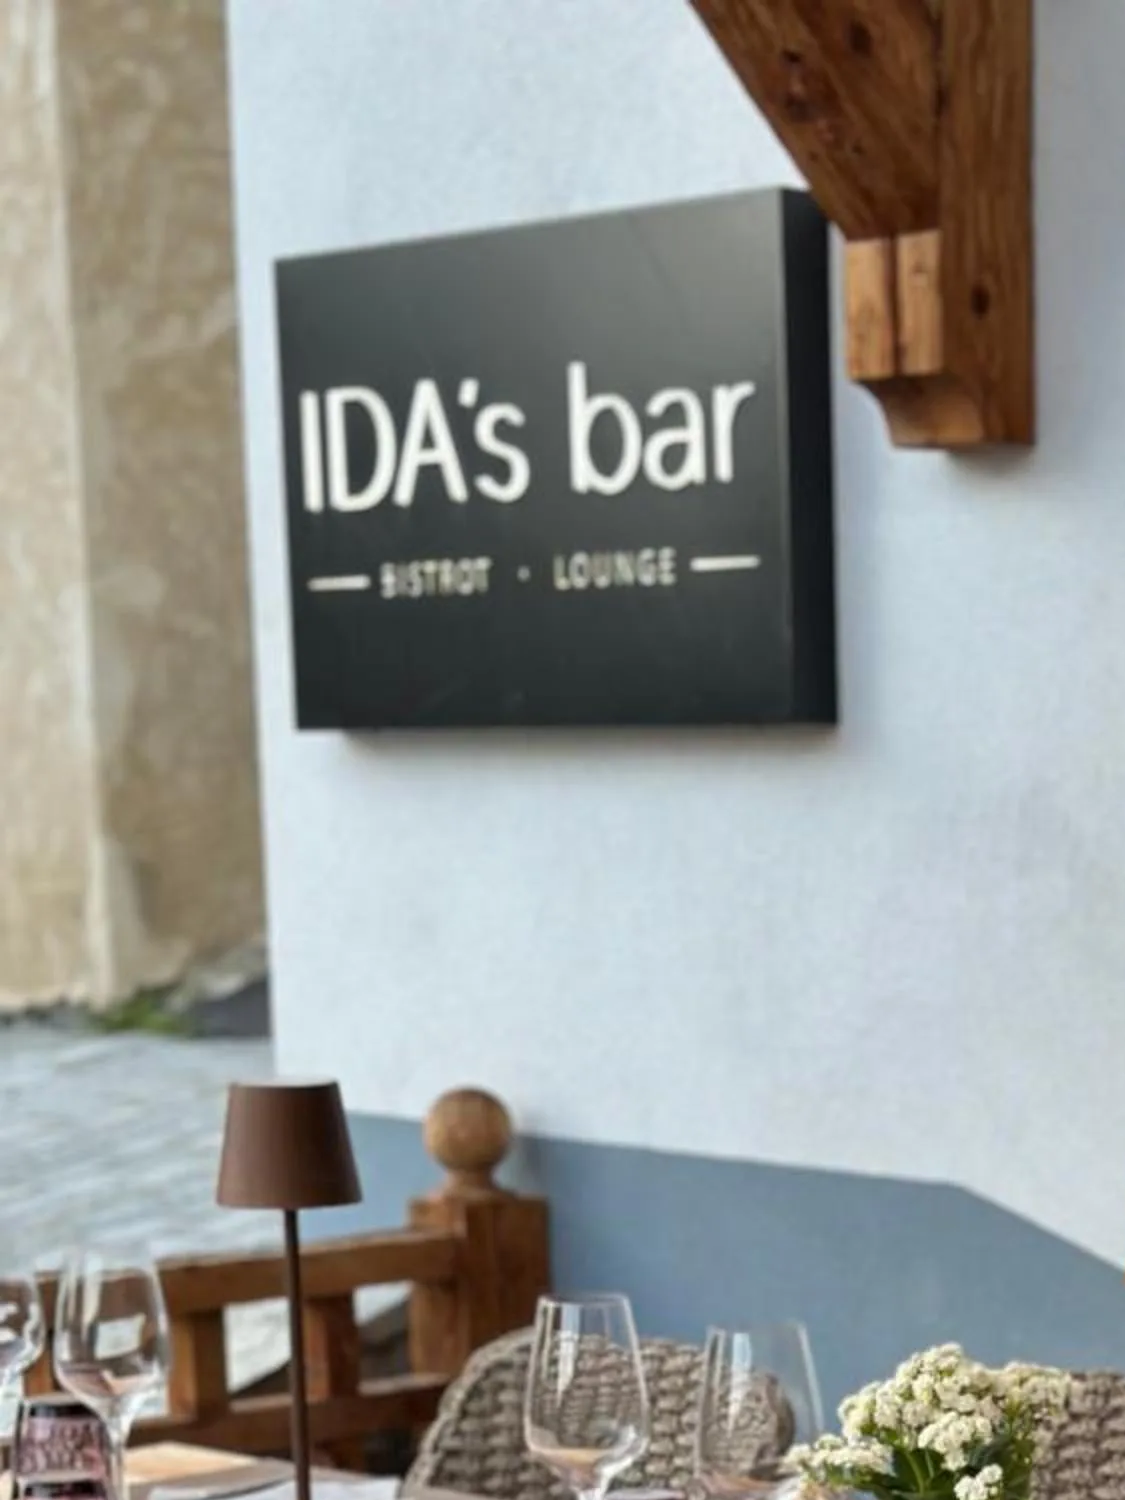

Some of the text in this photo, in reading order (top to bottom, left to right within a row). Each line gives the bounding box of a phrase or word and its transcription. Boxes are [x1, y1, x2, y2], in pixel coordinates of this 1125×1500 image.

[300, 360, 756, 514] IDA's bar
[380, 546, 677, 599] BISTROT LOUNGE
